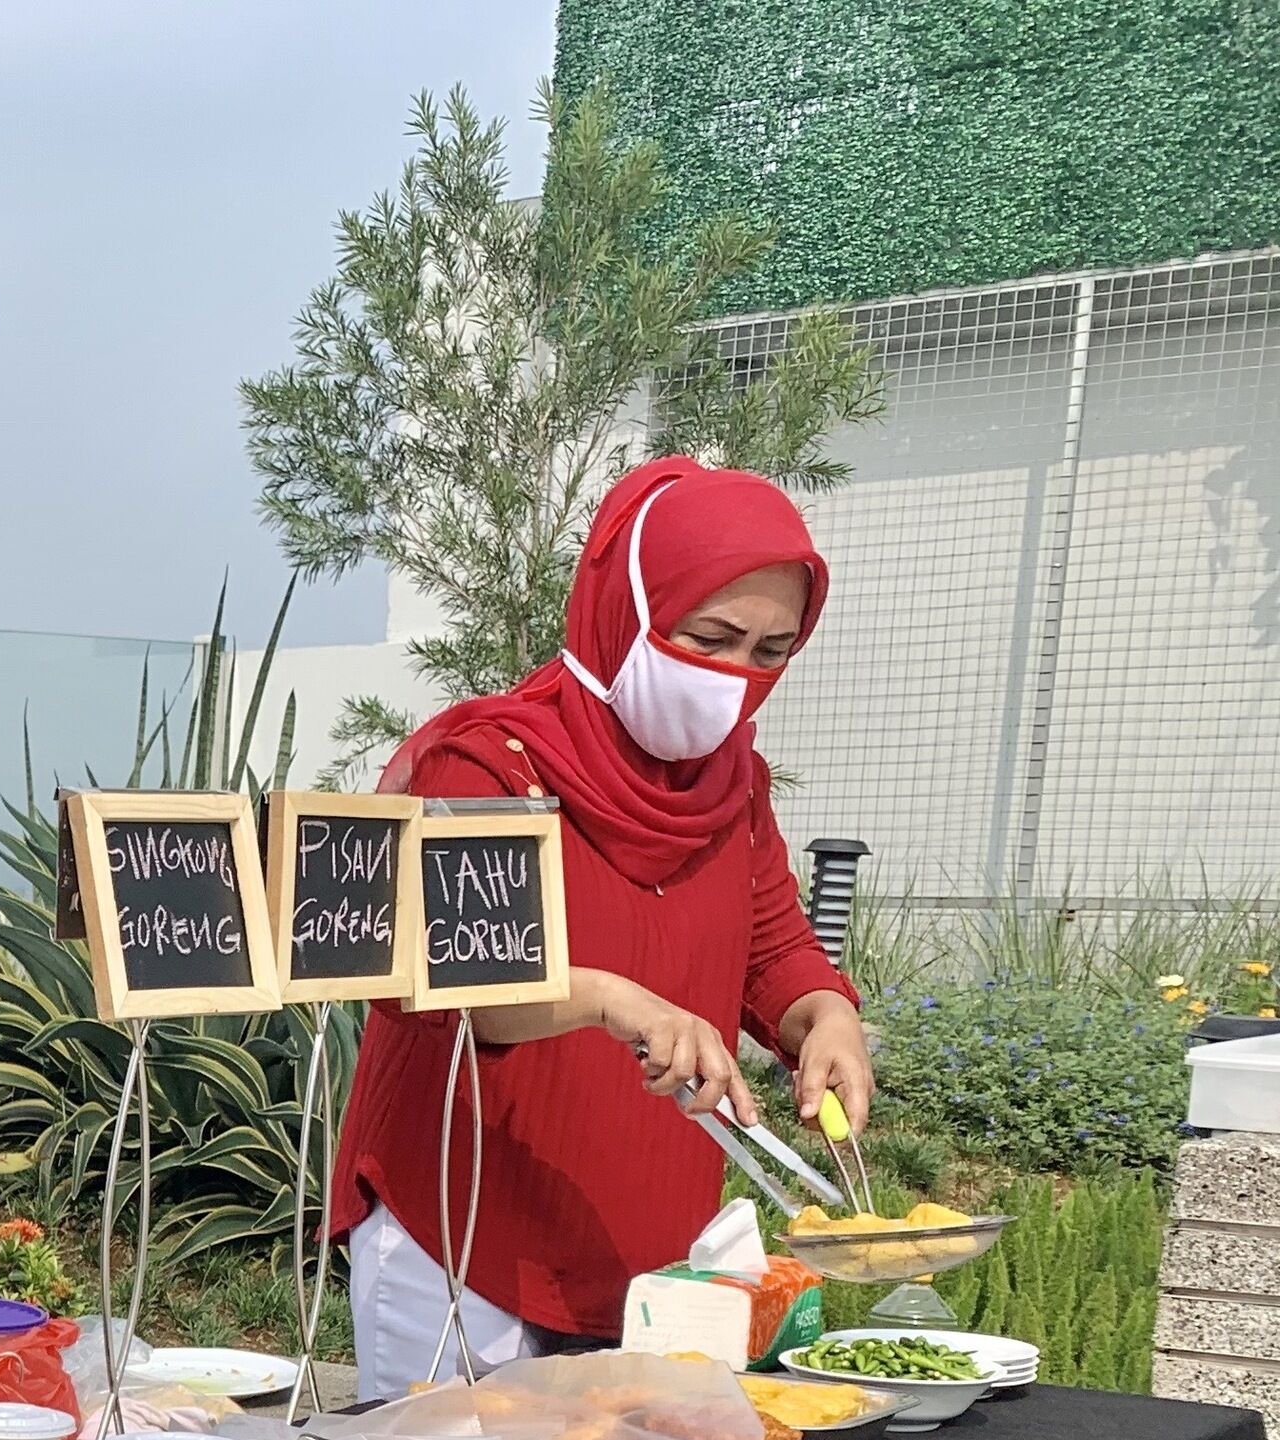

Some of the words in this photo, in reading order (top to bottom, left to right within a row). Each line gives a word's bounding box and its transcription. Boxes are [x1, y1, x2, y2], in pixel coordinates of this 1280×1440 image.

[425, 848, 528, 917] TAHU
[117, 903, 241, 957] GORENG
[291, 895, 393, 948] GORENG
[425, 917, 544, 966] GORENG
